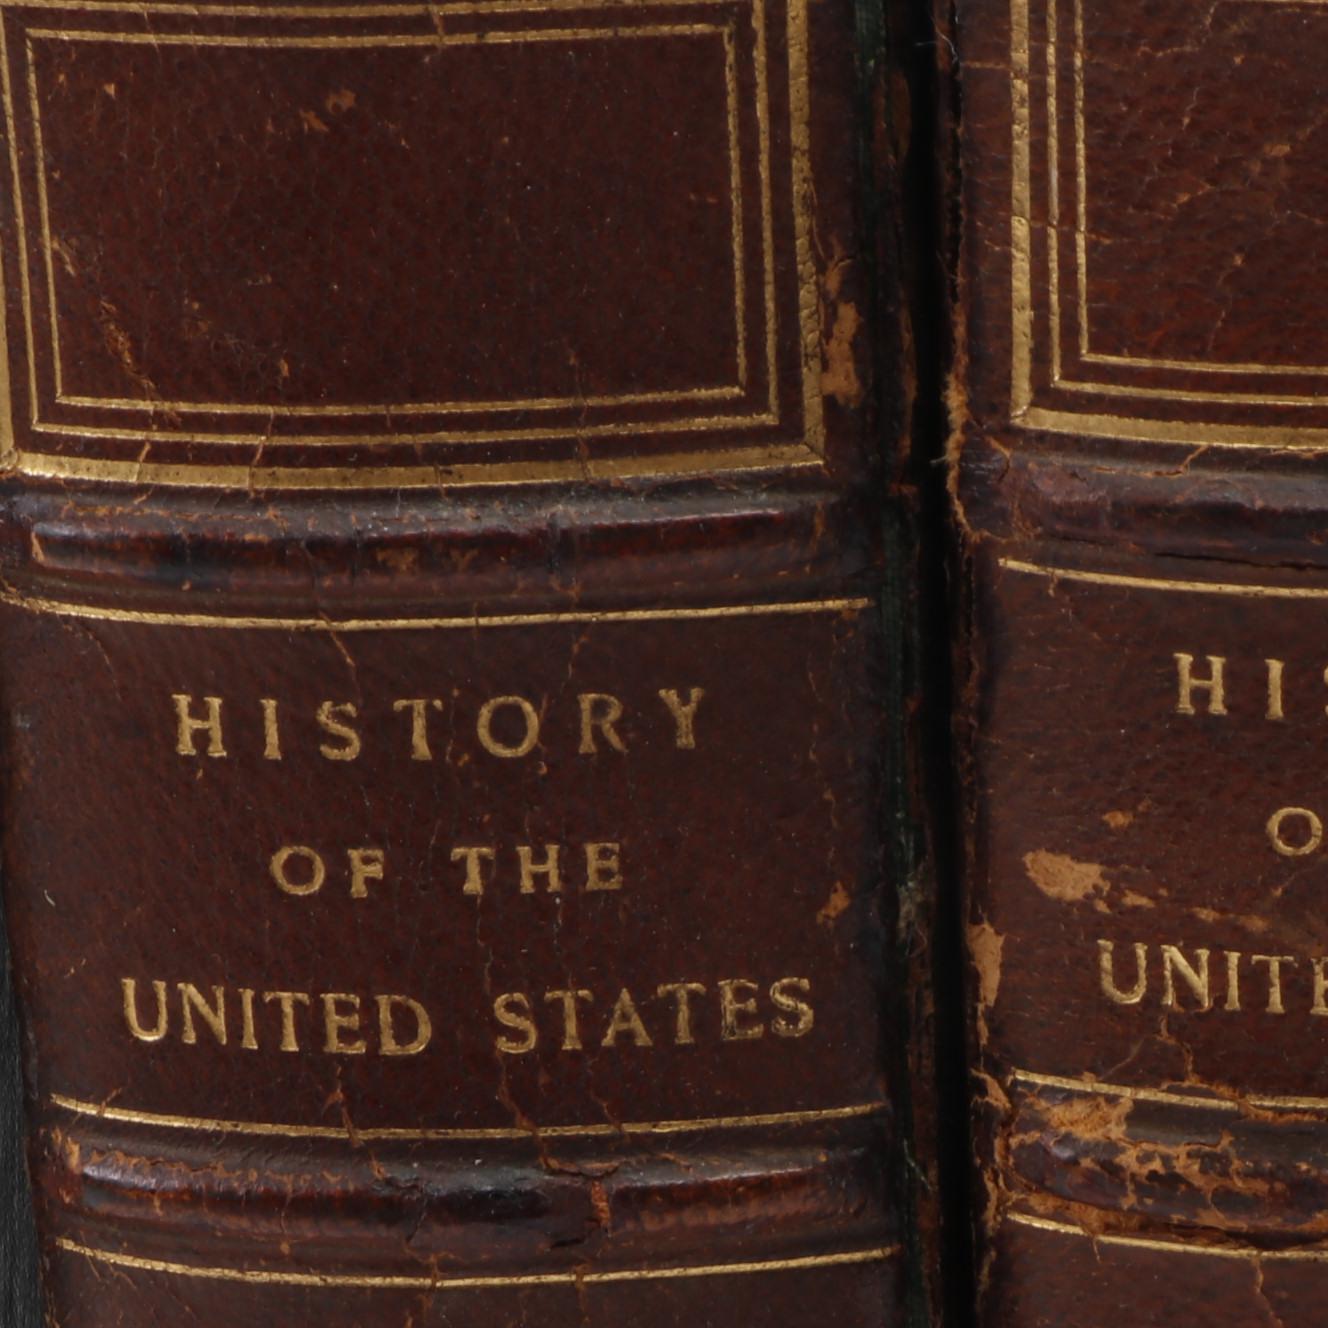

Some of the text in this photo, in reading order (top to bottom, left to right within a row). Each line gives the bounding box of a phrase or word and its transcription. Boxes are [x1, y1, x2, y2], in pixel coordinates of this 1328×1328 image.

[172, 687, 706, 761] HISTORY
[271, 841, 625, 898] OF THE
[120, 976, 814, 1055] UNITED STATES
